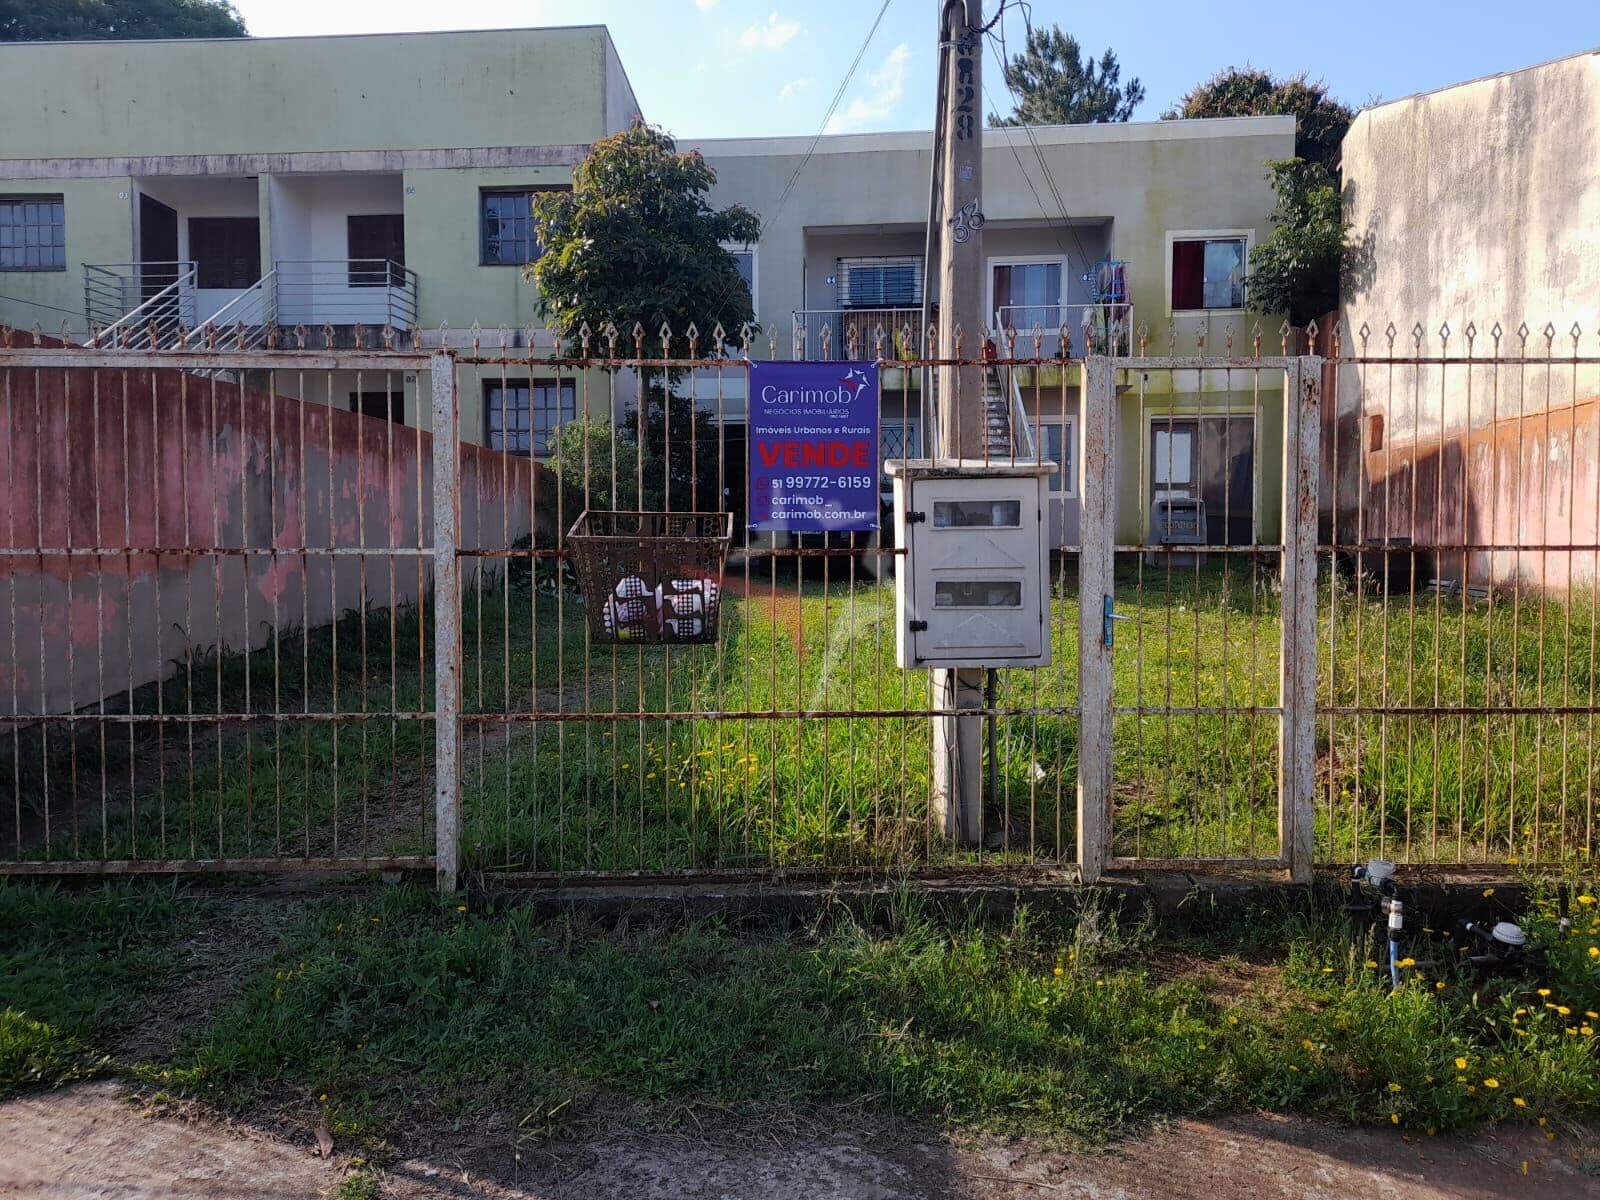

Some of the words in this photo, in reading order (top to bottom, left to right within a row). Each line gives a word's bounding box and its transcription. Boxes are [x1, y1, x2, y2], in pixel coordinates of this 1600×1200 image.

[761, 385, 852, 404] Carimob
[755, 426, 792, 434] Imóveis
[793, 426, 832, 434] Urbanos
[841, 426, 871, 434] Rurais
[757, 441, 870, 468] VENDE
[771, 479, 783, 489] 51
[785, 476, 871, 489] 99772-6159
[771, 509, 867, 520] carimob.com.br
